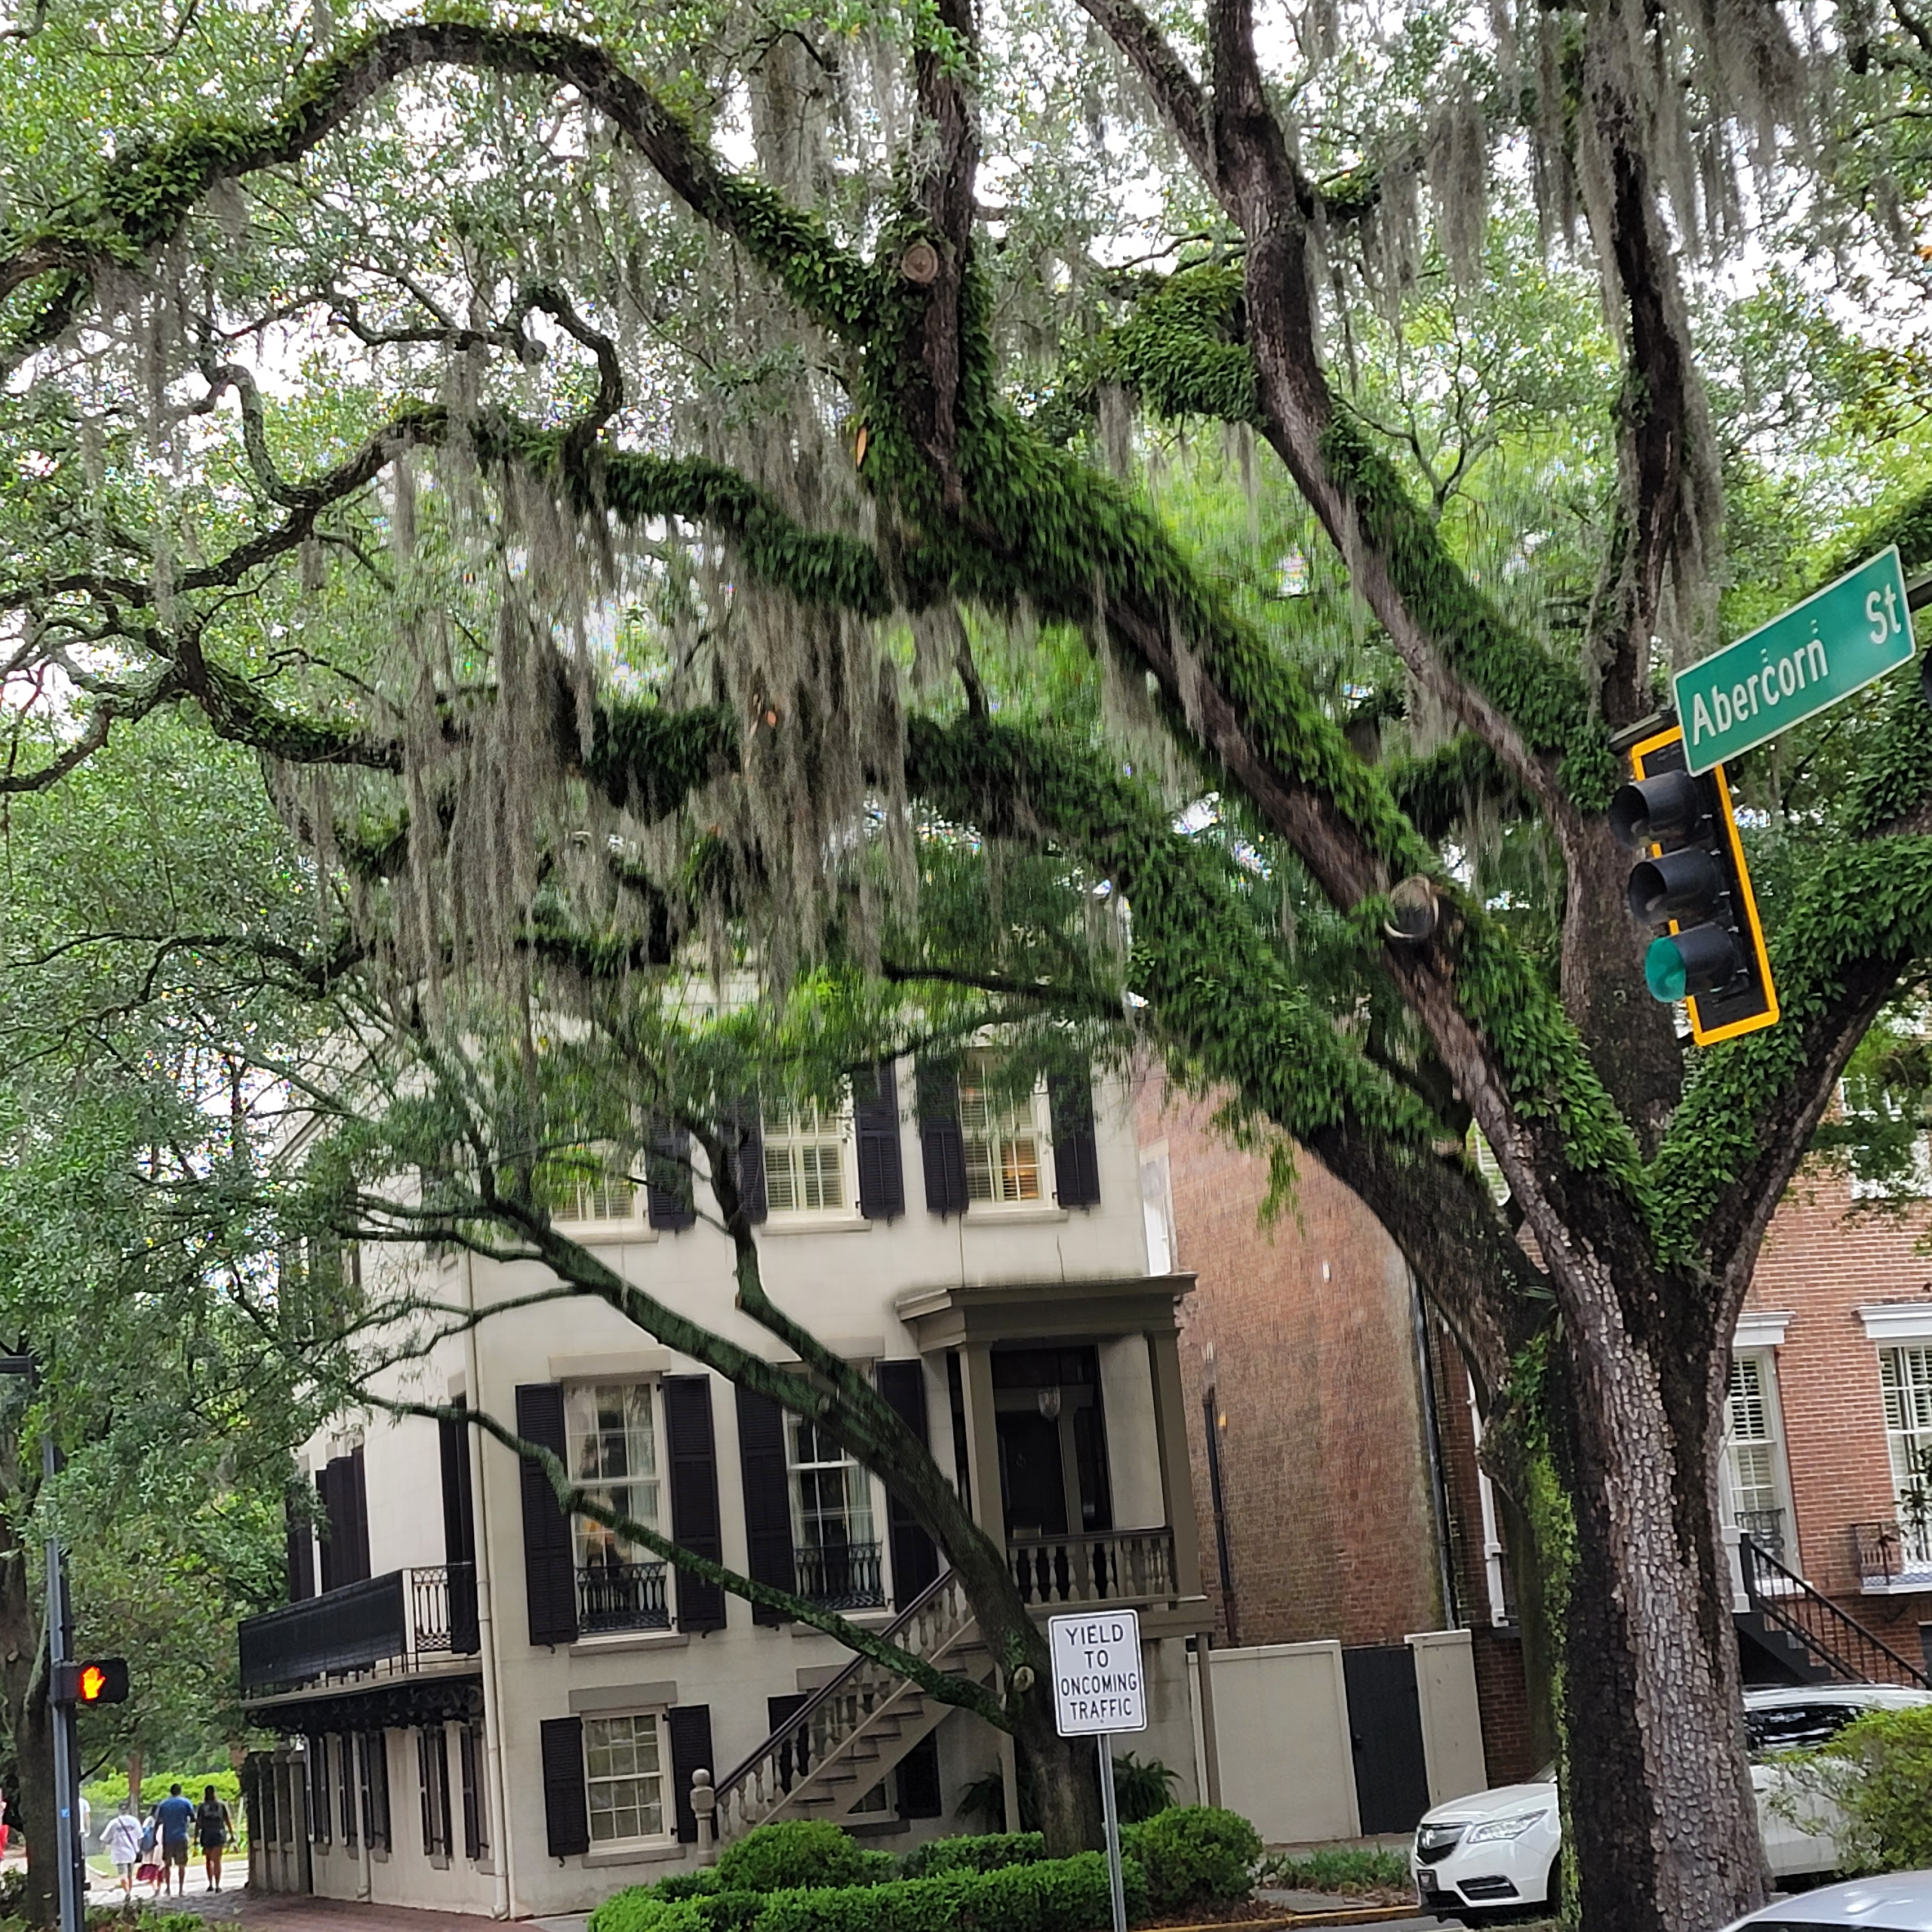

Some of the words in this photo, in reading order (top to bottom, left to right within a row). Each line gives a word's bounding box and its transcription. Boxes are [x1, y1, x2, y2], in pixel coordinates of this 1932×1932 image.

[1694, 638, 1828, 746] Abercorn
[1866, 583, 1901, 644] St
[1065, 1624, 1124, 1645] YIELD
[1084, 1650, 1109, 1669] TO
[1061, 1672, 1137, 1696] ONCOMING
[1070, 1698, 1132, 1720] TRAFFIC
